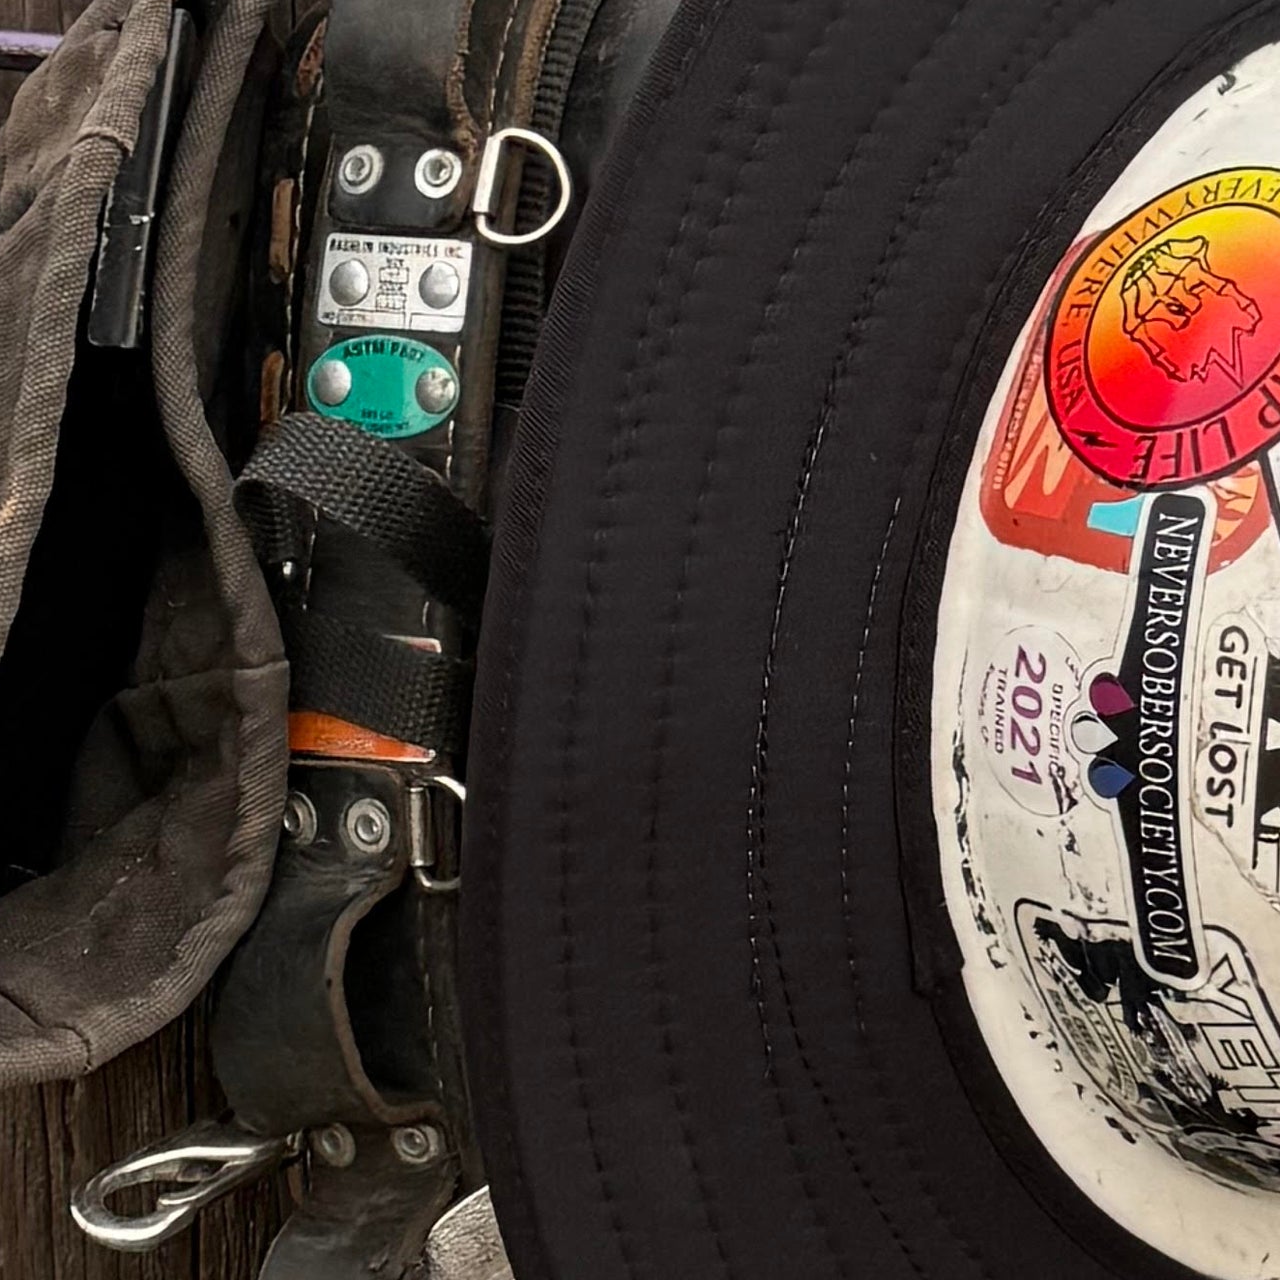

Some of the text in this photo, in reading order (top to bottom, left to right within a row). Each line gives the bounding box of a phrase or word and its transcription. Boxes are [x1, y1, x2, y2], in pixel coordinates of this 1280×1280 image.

[1054, 340, 1084, 414] USA
[1132, 416, 1238, 482] LIFE
[990, 666, 1008, 755] TRAINED
[1009, 643, 1048, 787] 2021
[1138, 514, 1198, 966] NEVERSOBERSOCIETY.COM
[1205, 625, 1250, 829] GET LOST
